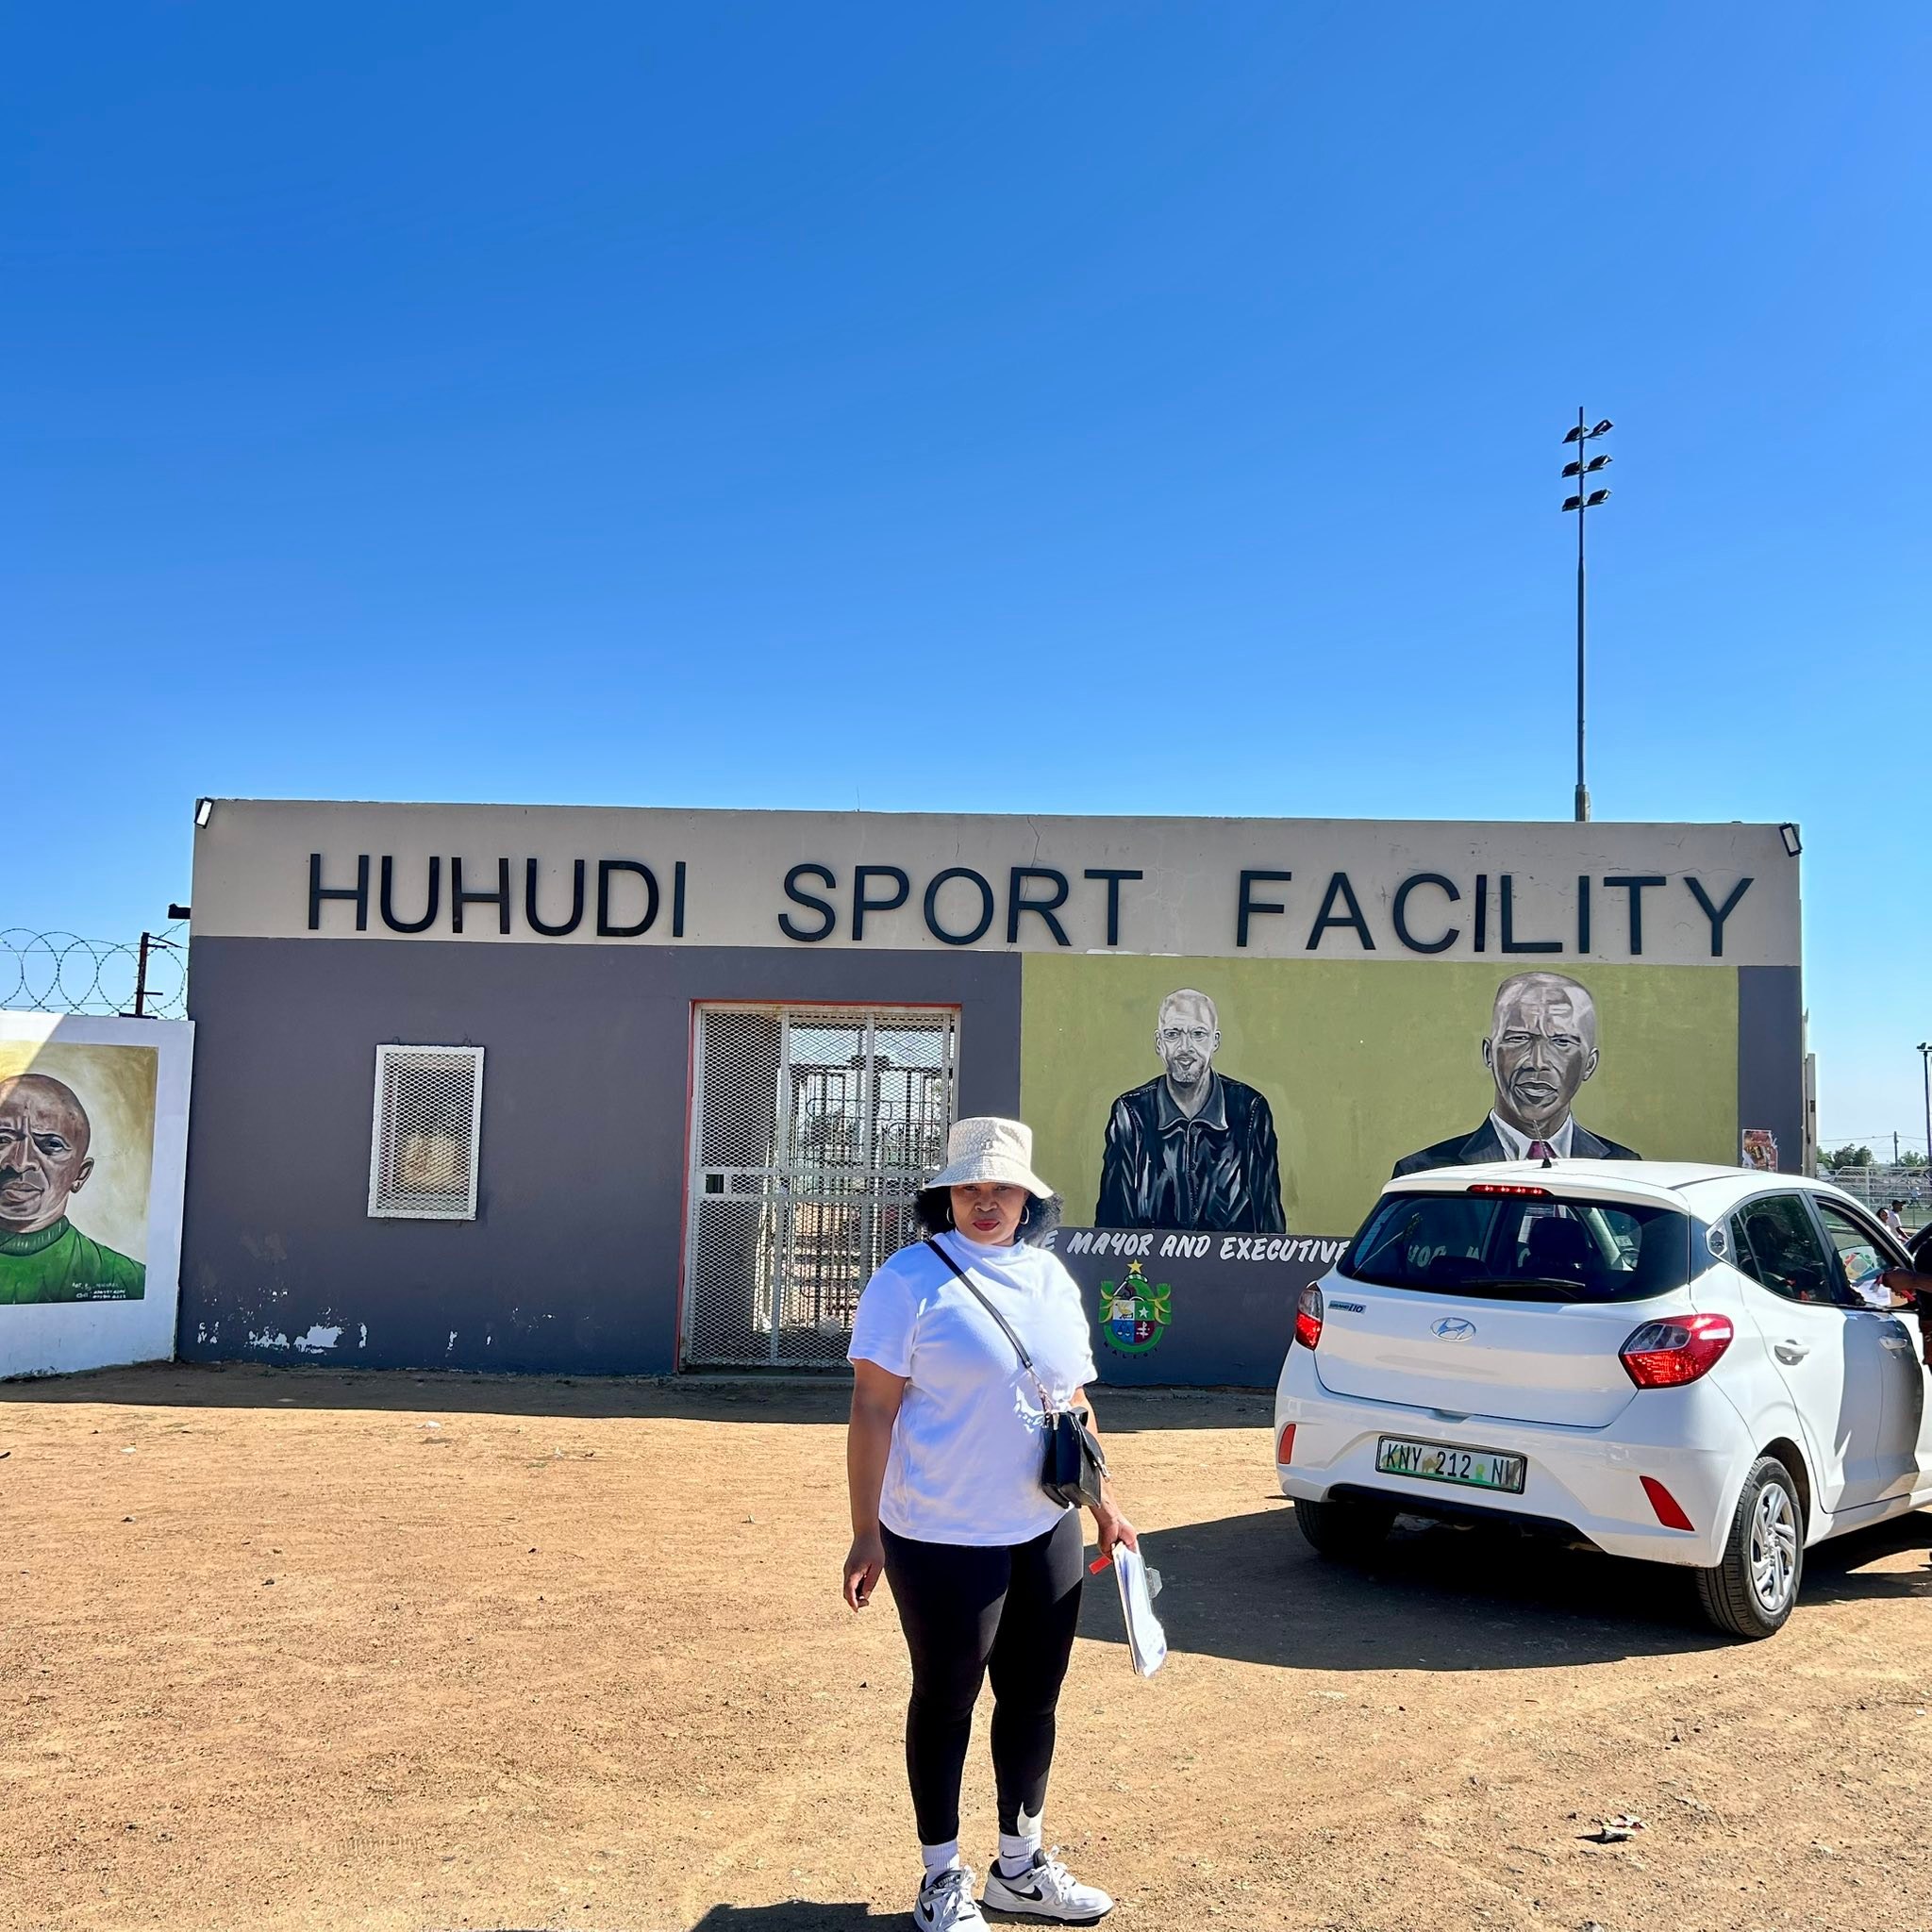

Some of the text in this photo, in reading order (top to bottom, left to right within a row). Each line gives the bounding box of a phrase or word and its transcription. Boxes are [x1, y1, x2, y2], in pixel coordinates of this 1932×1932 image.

[308, 853, 1755, 957] HUHUDI SPORT FACILITY
[1067, 1231, 1154, 1257] MAYOR
[1159, 1234, 1211, 1258] AND
[1387, 1443, 1423, 1472] KNY
[1436, 1451, 1472, 1479] 212
